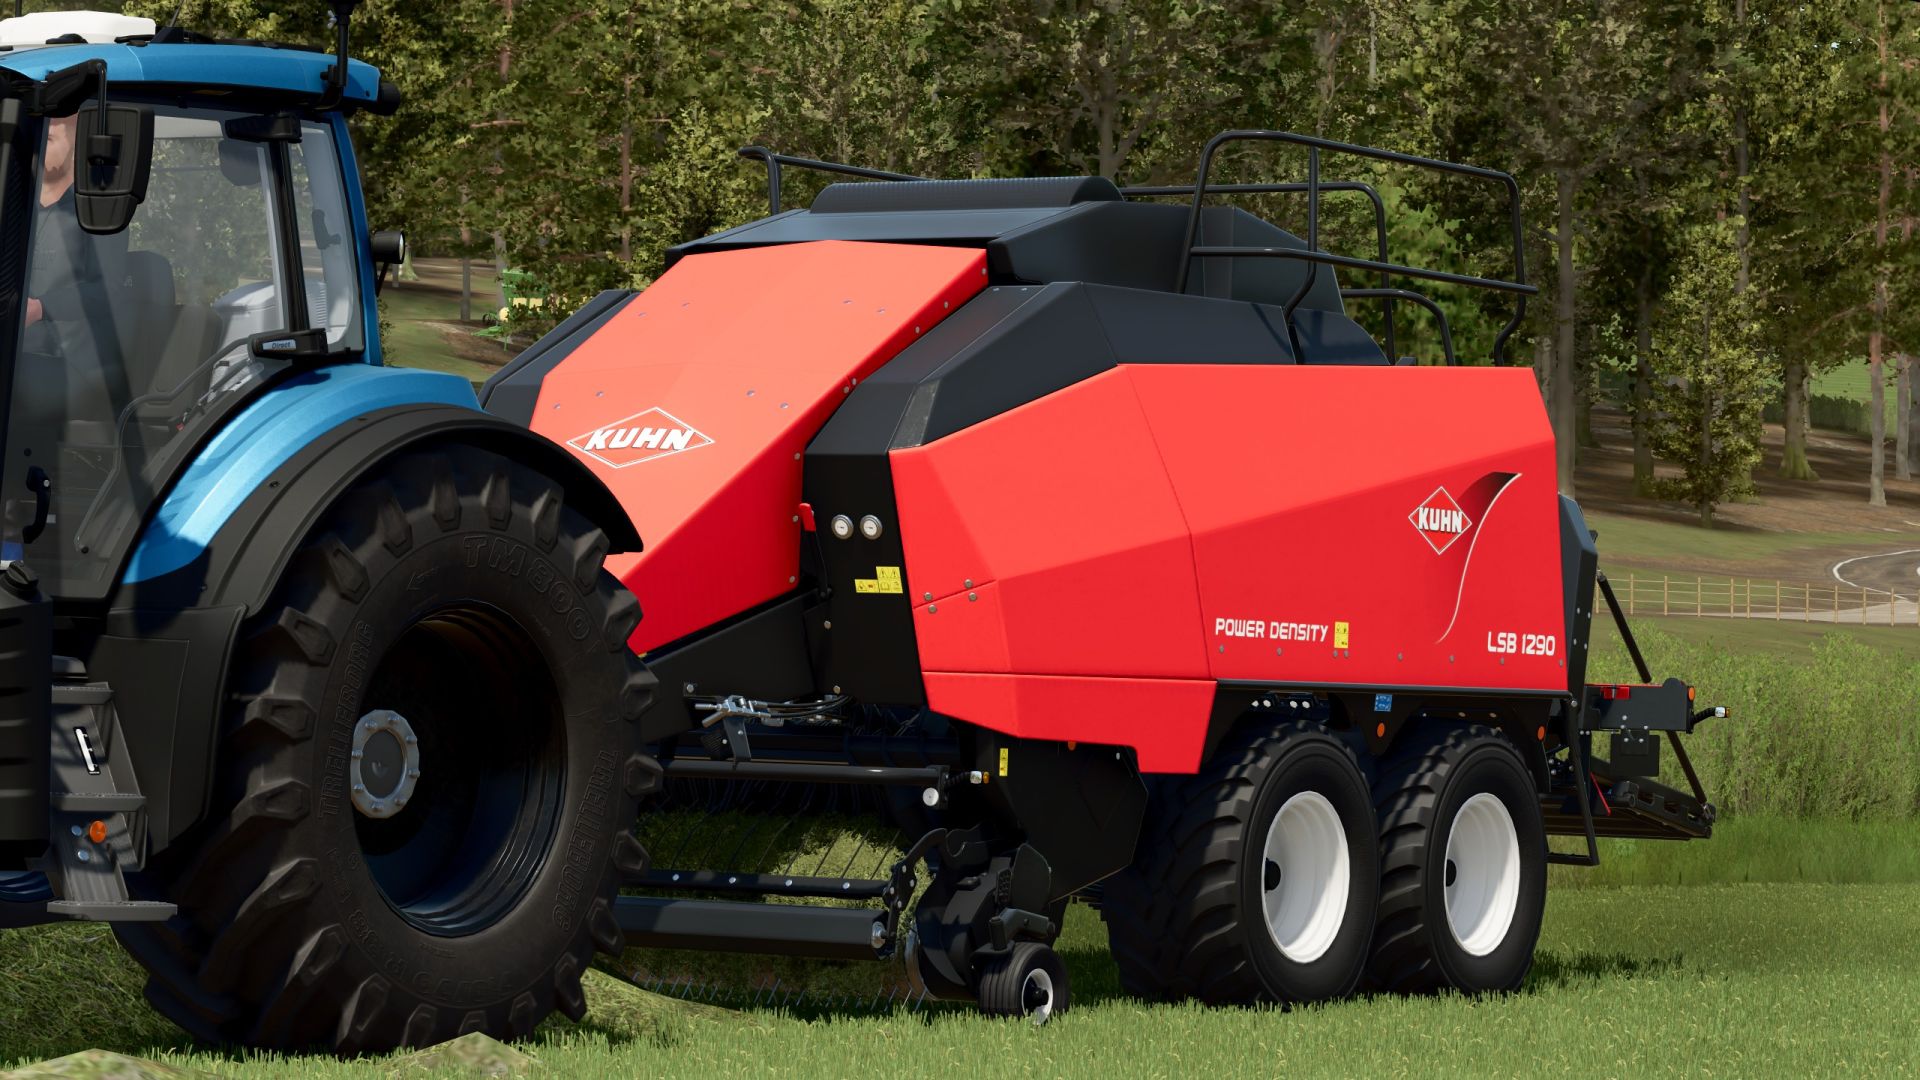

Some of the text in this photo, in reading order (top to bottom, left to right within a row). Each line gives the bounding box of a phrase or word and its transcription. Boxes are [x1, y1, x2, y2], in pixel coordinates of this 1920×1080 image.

[584, 427, 694, 450] KUHN
[1418, 507, 1462, 533] KUHN
[464, 534, 591, 640] TM800
[1215, 618, 1329, 643] POWER DENSITY
[1488, 631, 1556, 656] LSB 1290
[317, 620, 375, 818] TRELLEBORG
[552, 750, 620, 932] TRELLEBORG
